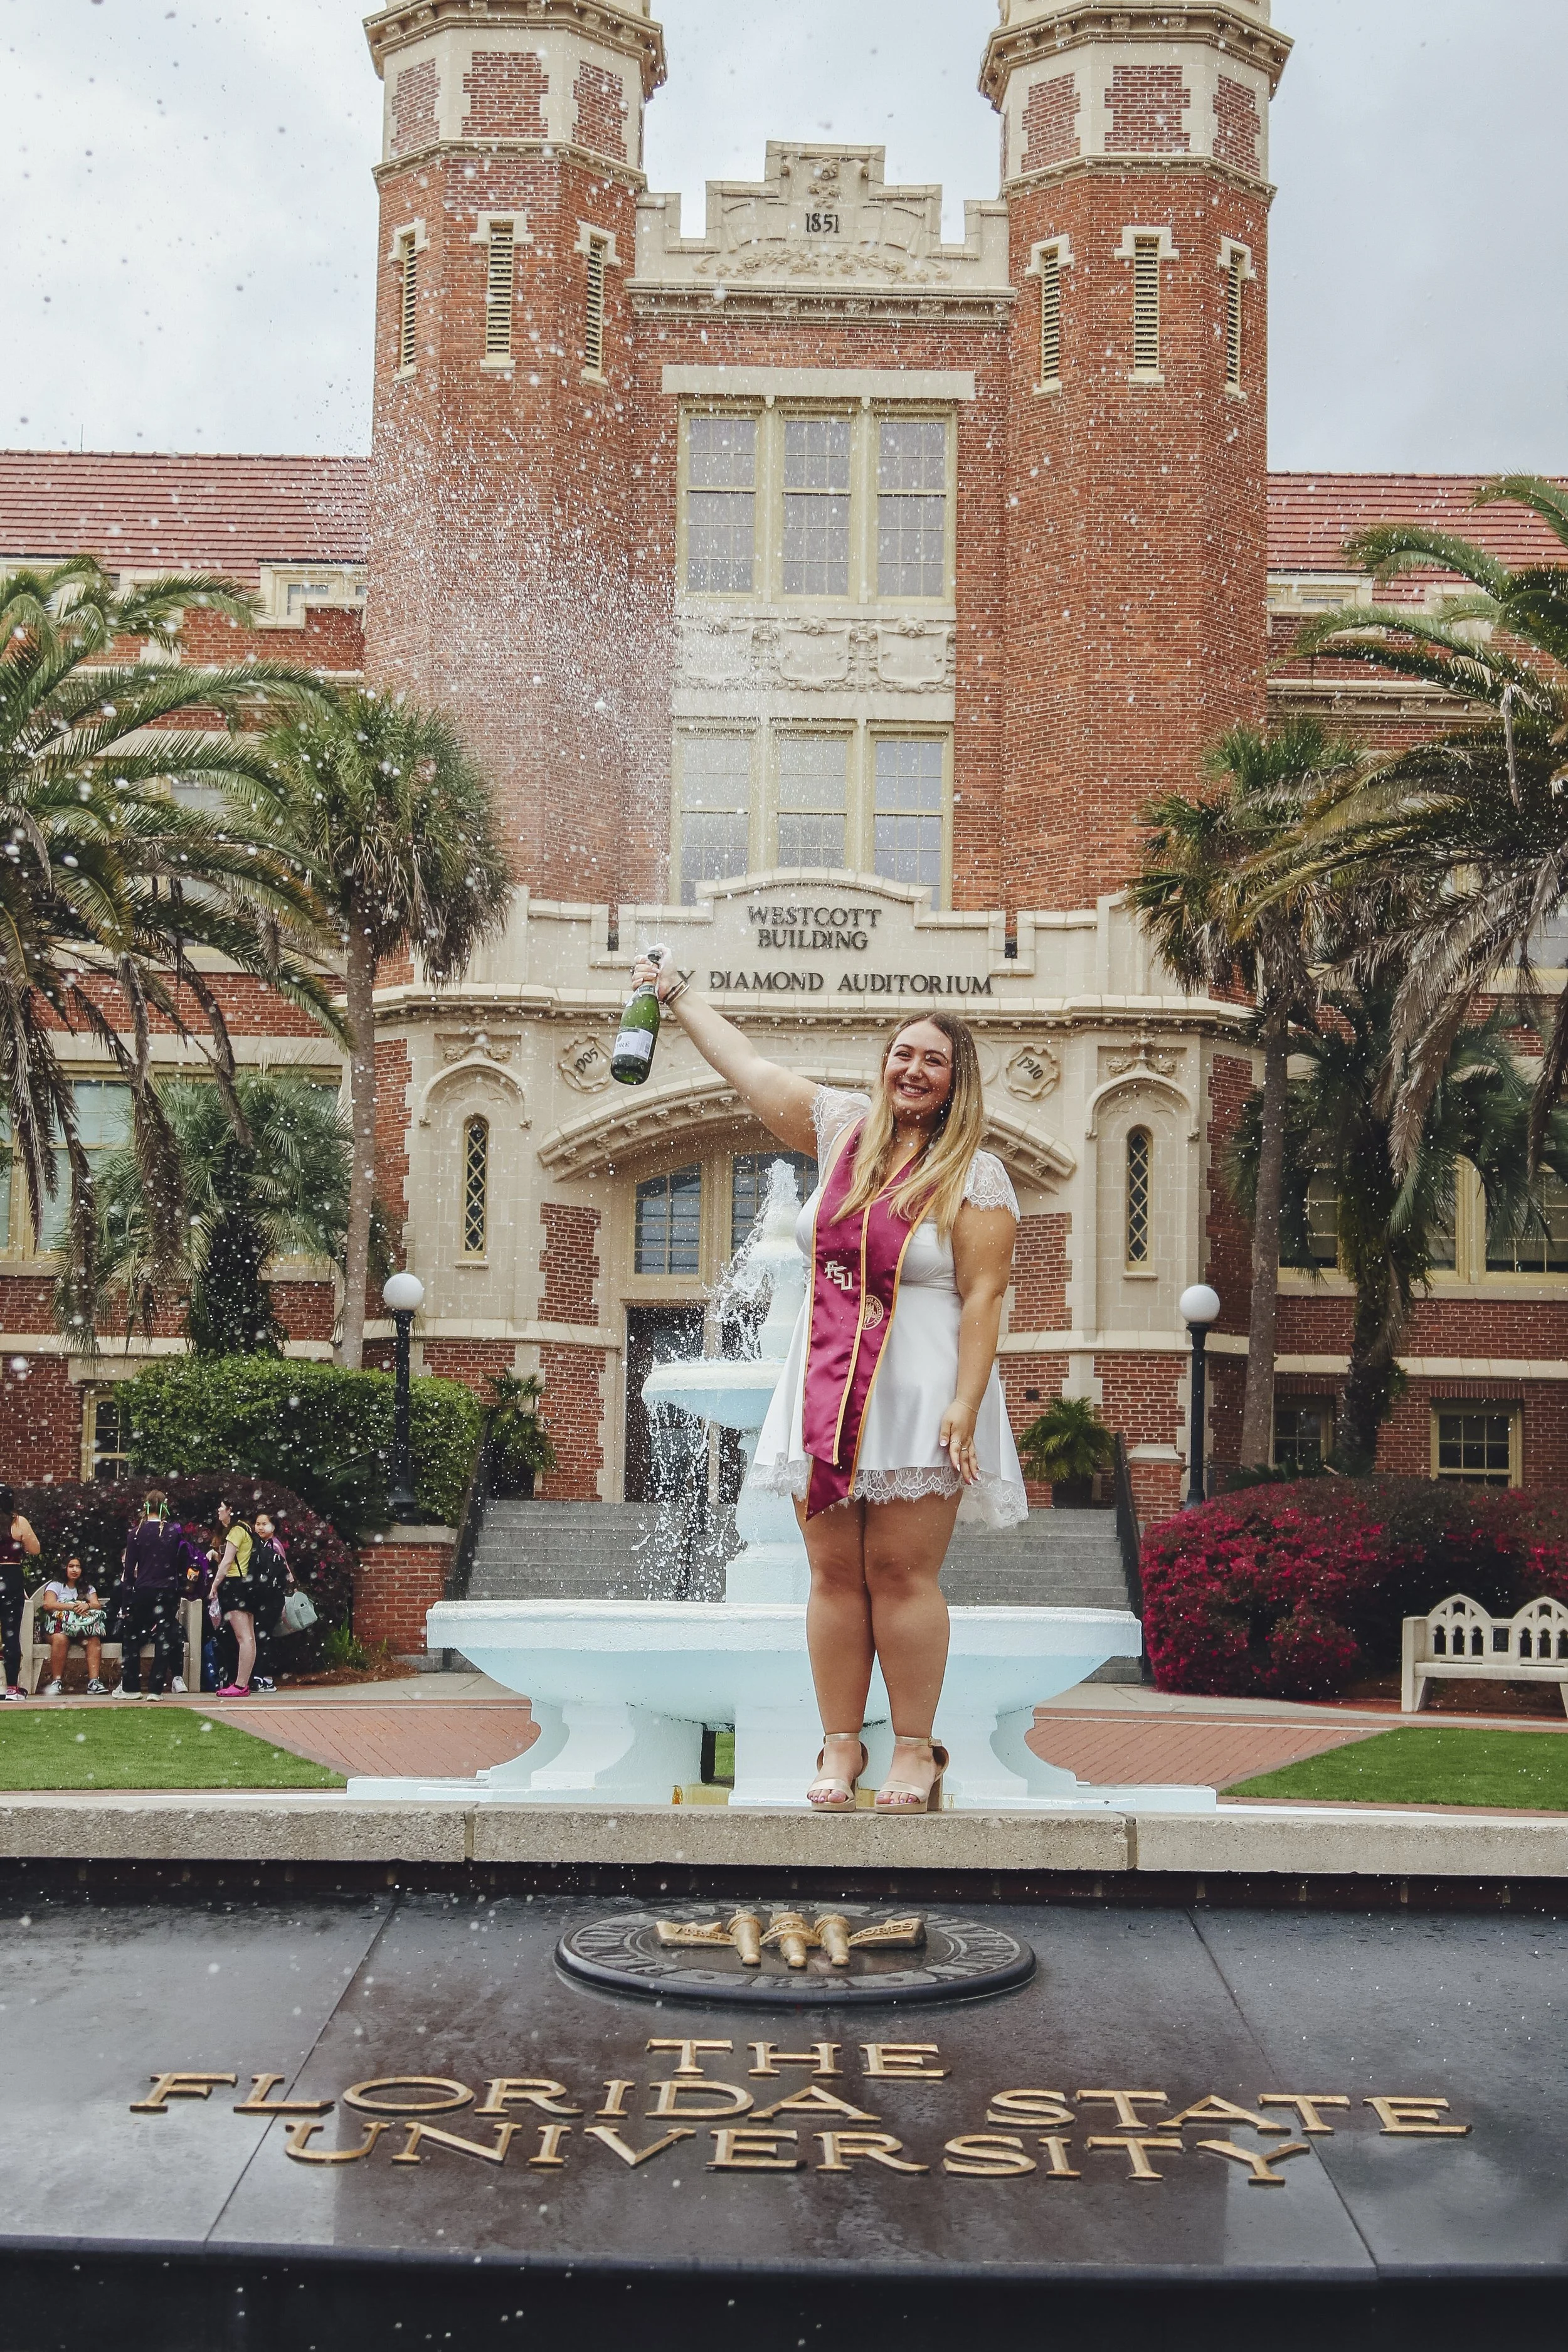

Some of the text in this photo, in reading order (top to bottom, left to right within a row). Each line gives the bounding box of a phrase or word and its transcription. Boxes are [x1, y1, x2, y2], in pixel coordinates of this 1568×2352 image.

[805, 213, 840, 233] 1851
[747, 906, 882, 927] WESTCOTT
[757, 929, 868, 949] BUILDING
[709, 970, 824, 990] DIAMOND
[837, 973, 993, 994] AUDITORIUM
[1017, 1056, 1044, 1079] 1910
[824, 1260, 853, 1291] FSU
[849, 1922, 914, 1941] MORES
[645, 2038, 952, 2078] THE
[129, 2072, 1473, 2135] FLORIDA STATE
[285, 2121, 1311, 2185] UNIVERSITY
